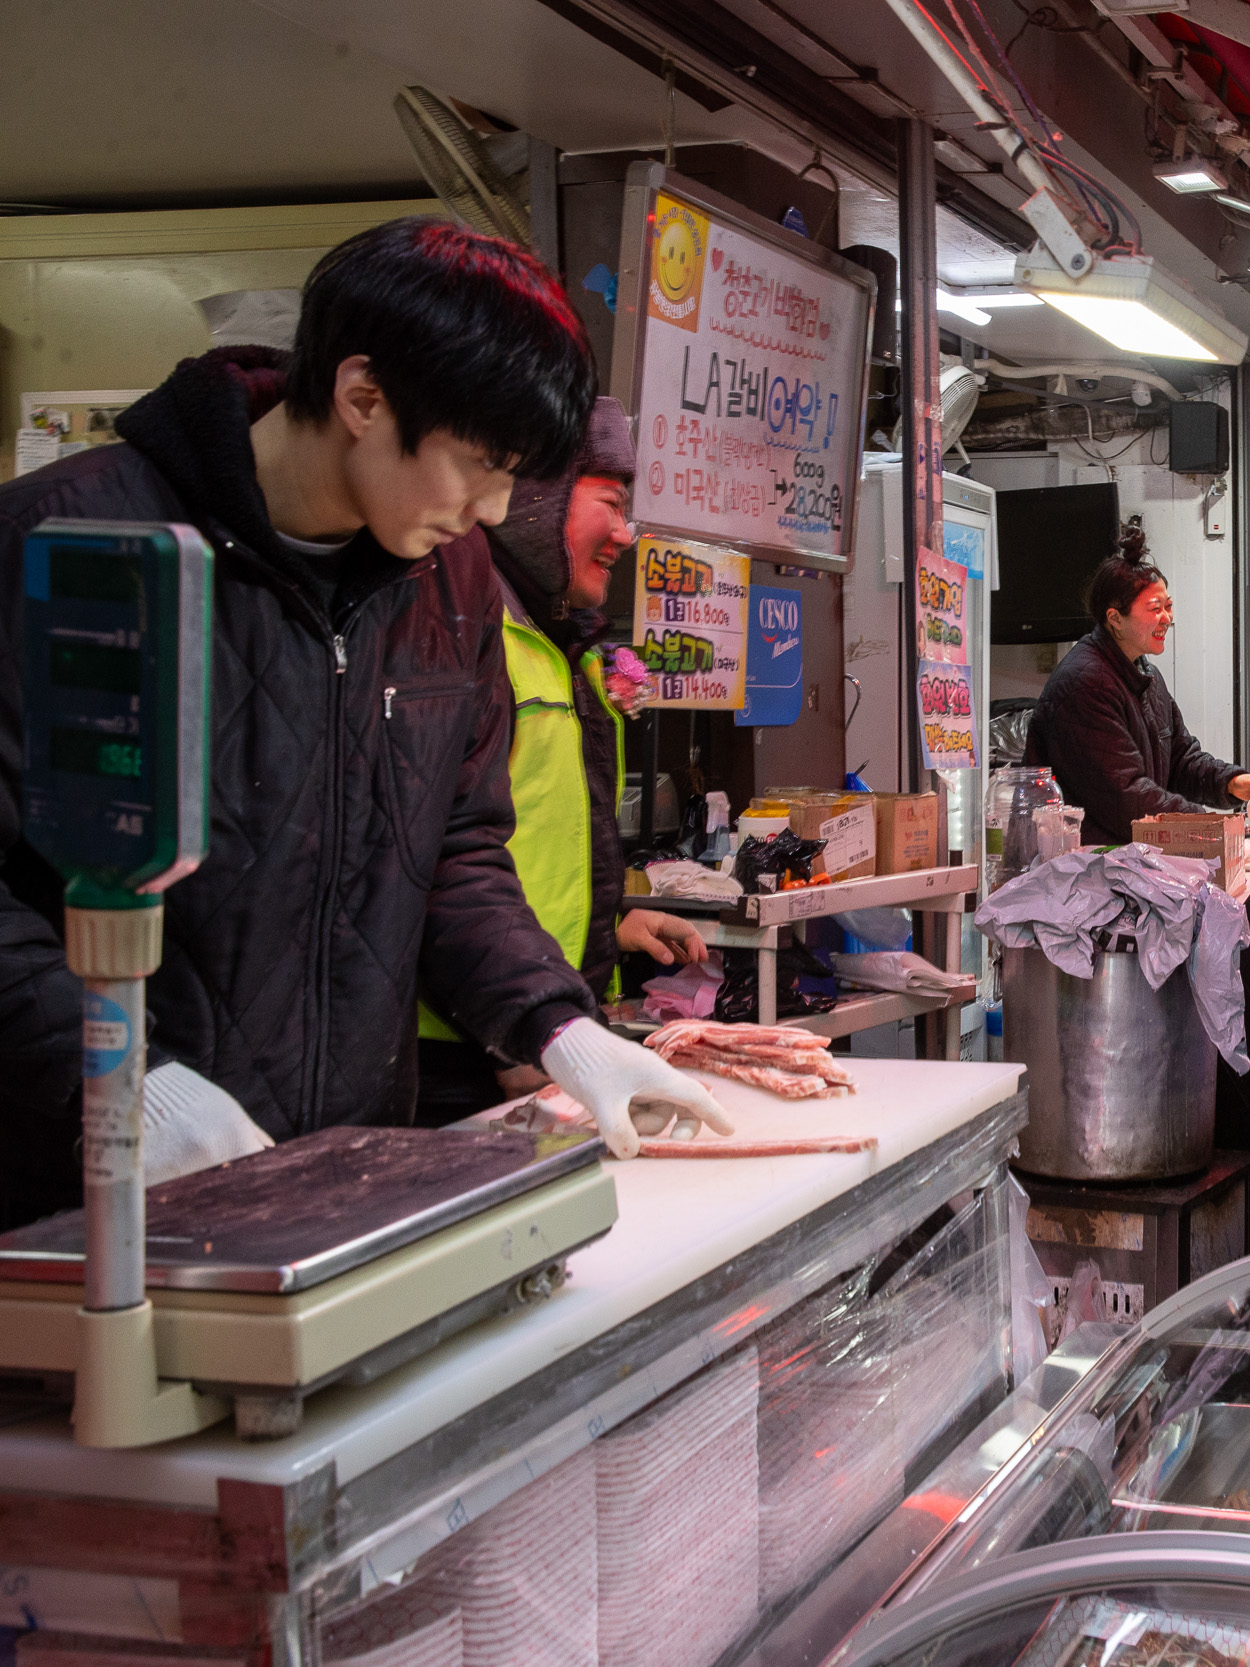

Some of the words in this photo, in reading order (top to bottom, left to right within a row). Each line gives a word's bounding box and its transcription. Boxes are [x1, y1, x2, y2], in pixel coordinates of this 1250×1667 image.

[645, 547, 714, 598] 소불고기
[759, 597, 799, 631] CESCO
[644, 627, 715, 674] 소불고기
